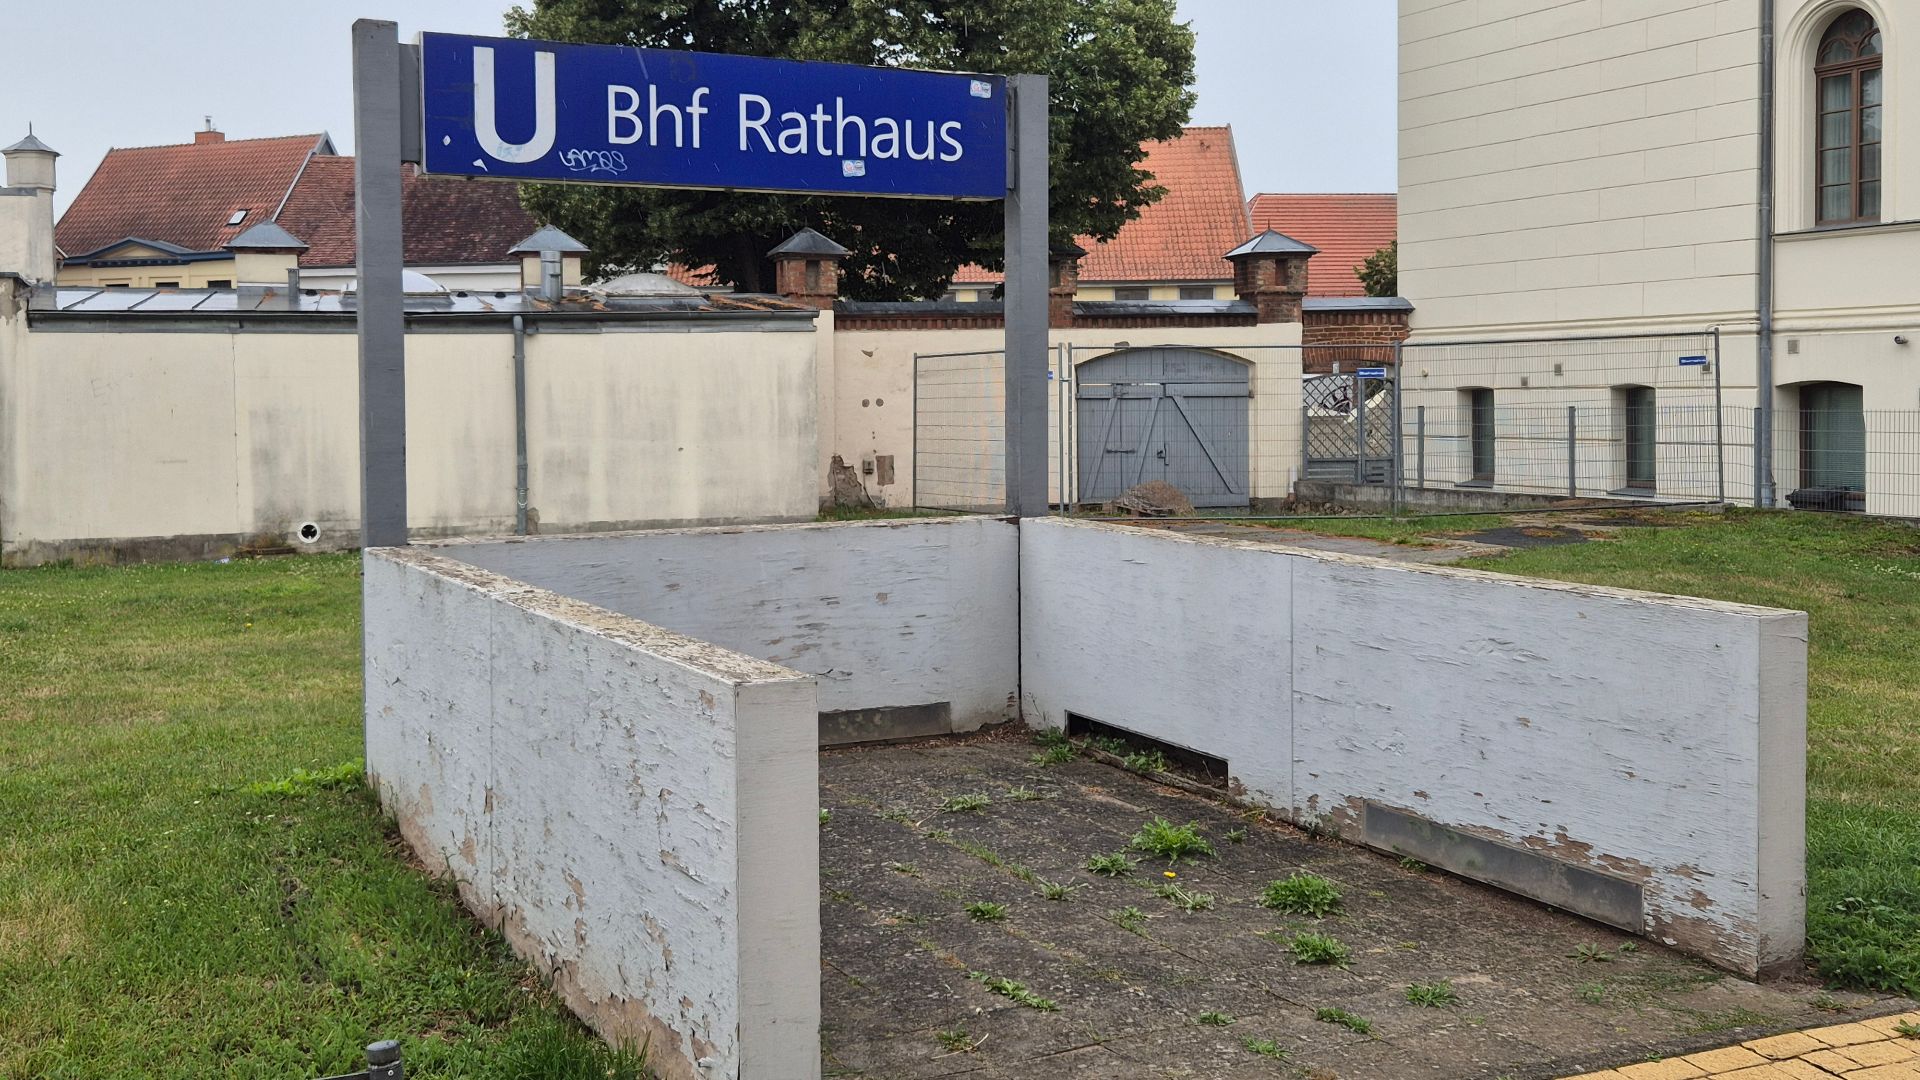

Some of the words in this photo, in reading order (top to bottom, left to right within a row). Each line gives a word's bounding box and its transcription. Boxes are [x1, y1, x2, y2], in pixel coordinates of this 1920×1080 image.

[474, 47, 555, 163] U
[608, 85, 709, 148] Bhf
[740, 94, 962, 161] Rathaus
